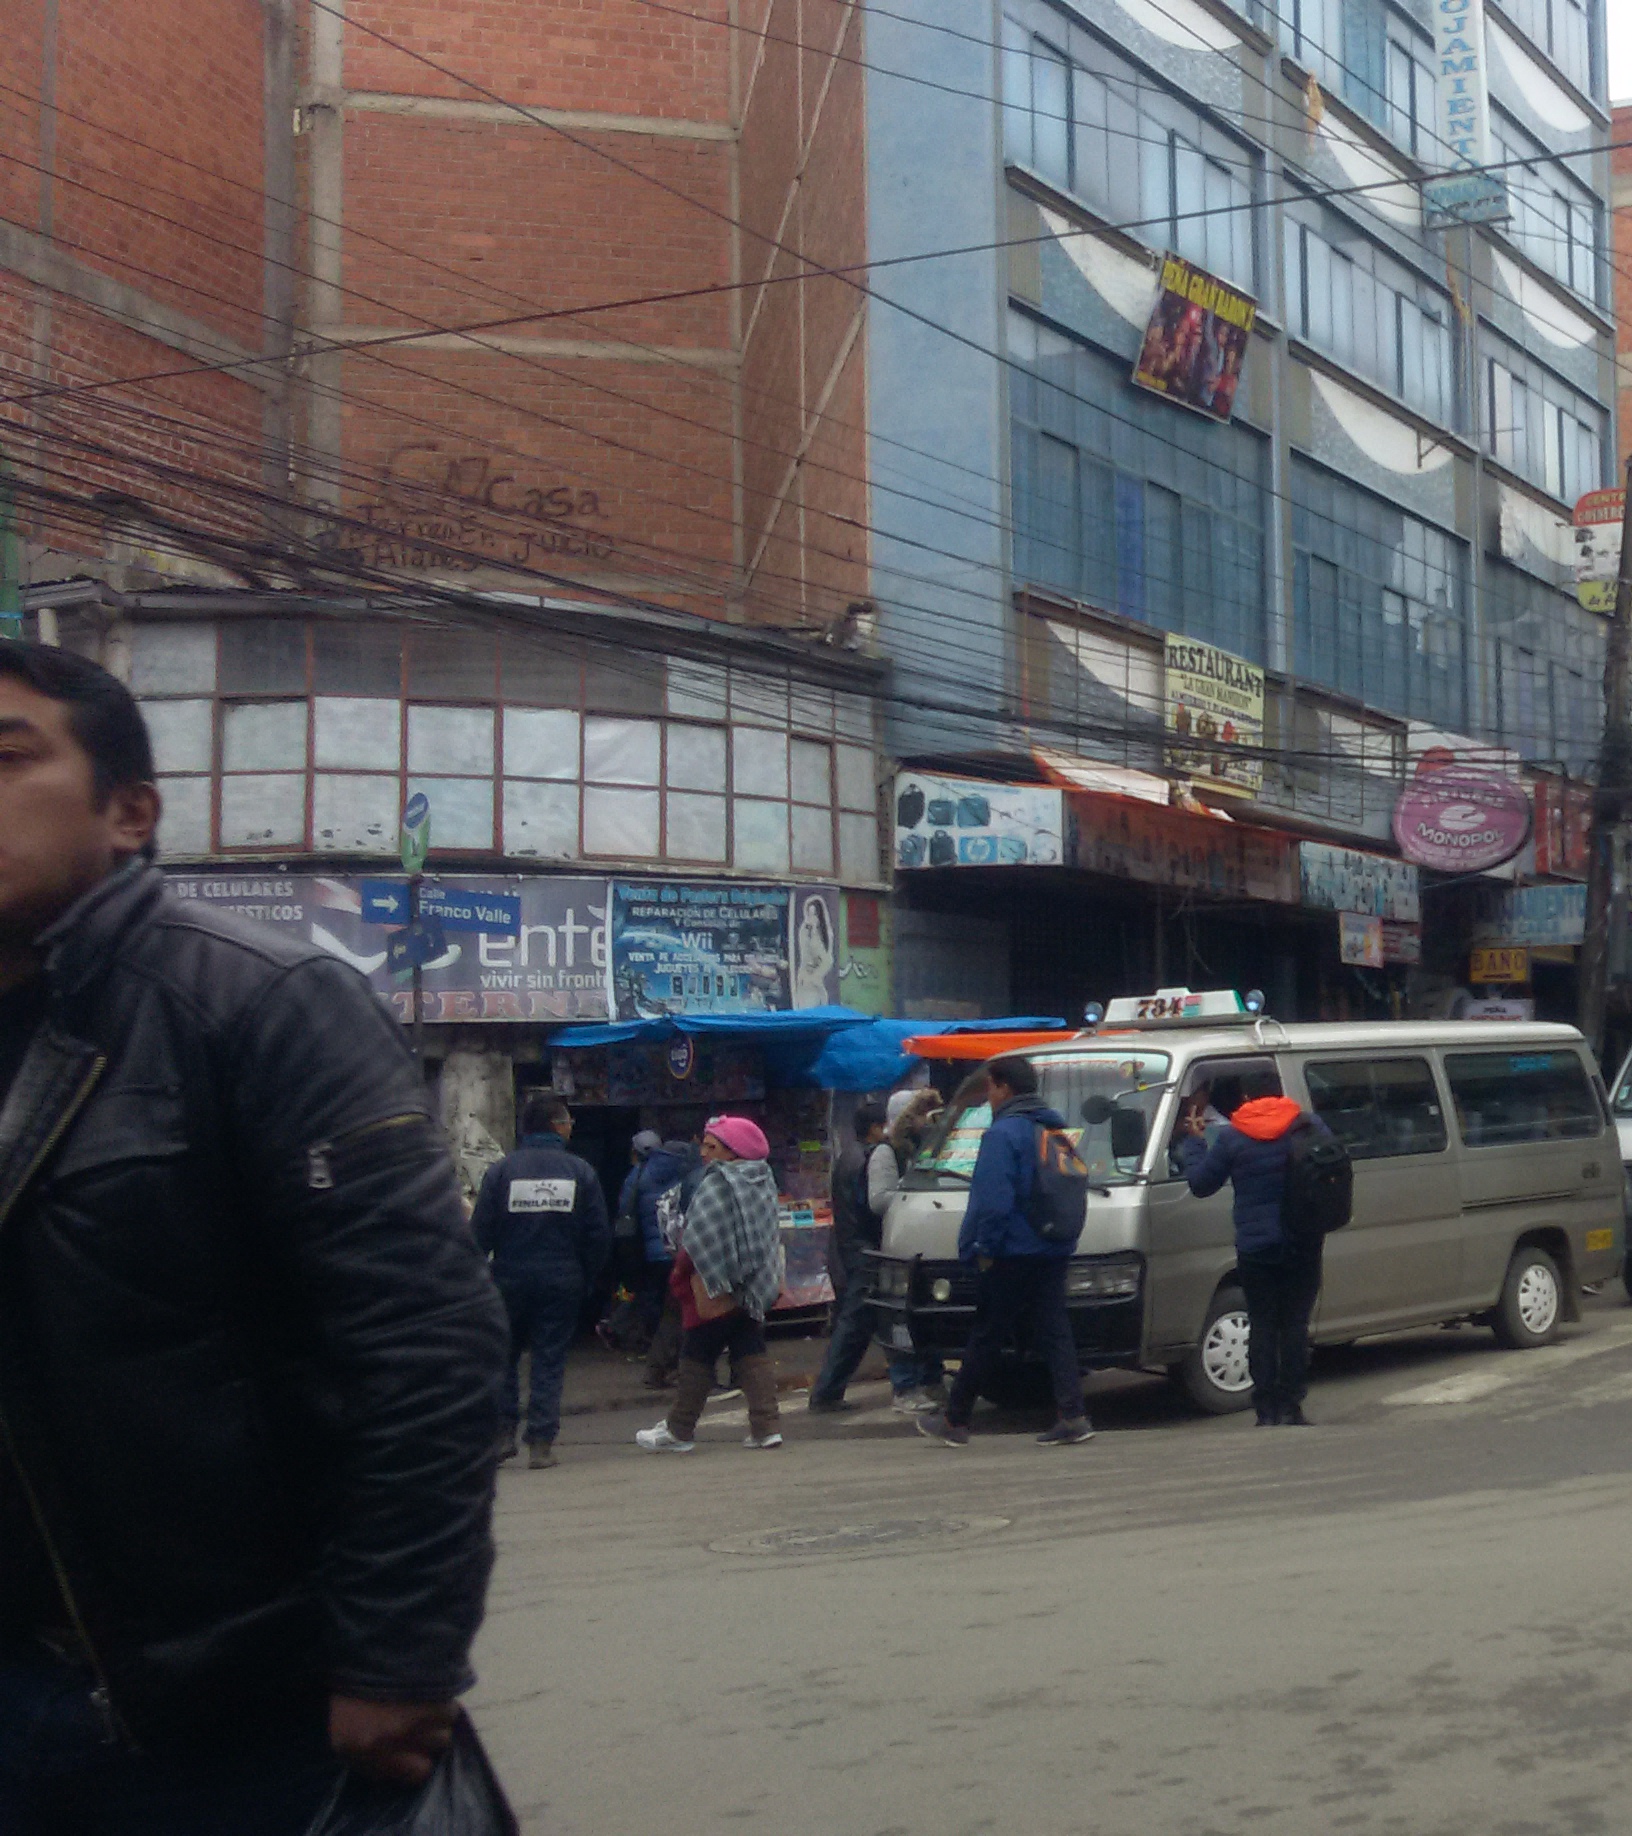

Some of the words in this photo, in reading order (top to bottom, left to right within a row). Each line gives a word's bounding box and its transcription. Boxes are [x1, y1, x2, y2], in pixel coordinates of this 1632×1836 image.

[1166, 644, 1263, 698] RESTAURANT
[203, 879, 295, 899] CELULARES
[418, 885, 446, 901] Calle
[418, 901, 472, 921] Franco
[475, 904, 512, 925] Valle
[681, 932, 714, 951] Wii
[480, 972, 522, 989] vivir
[528, 971, 554, 989] sin
